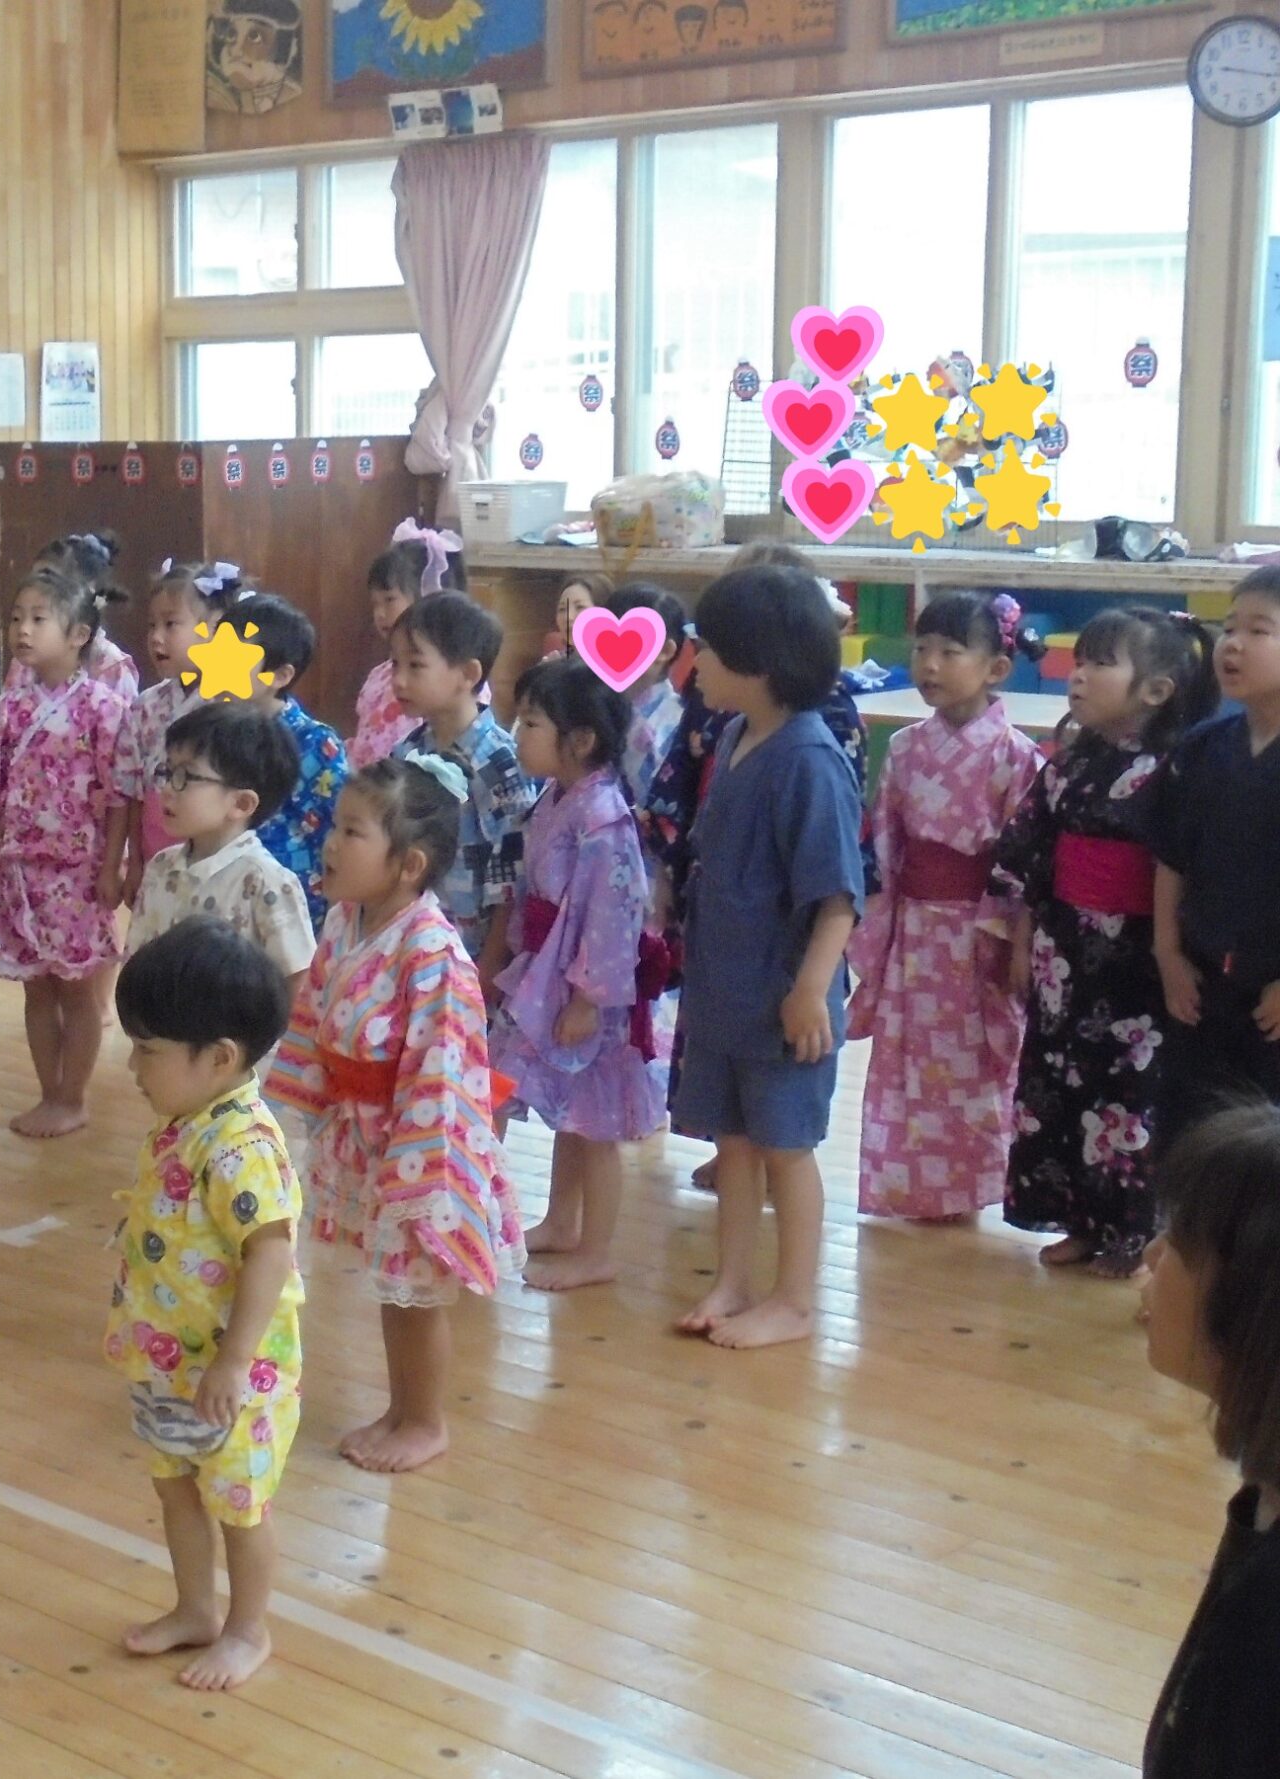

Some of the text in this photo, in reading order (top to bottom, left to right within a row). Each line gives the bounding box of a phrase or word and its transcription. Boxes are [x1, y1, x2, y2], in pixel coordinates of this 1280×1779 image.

[1130, 354, 1153, 377] 祭
[226, 460, 242, 480] 祭
[271, 460, 286, 478] 祭
[313, 456, 328, 475] 祭
